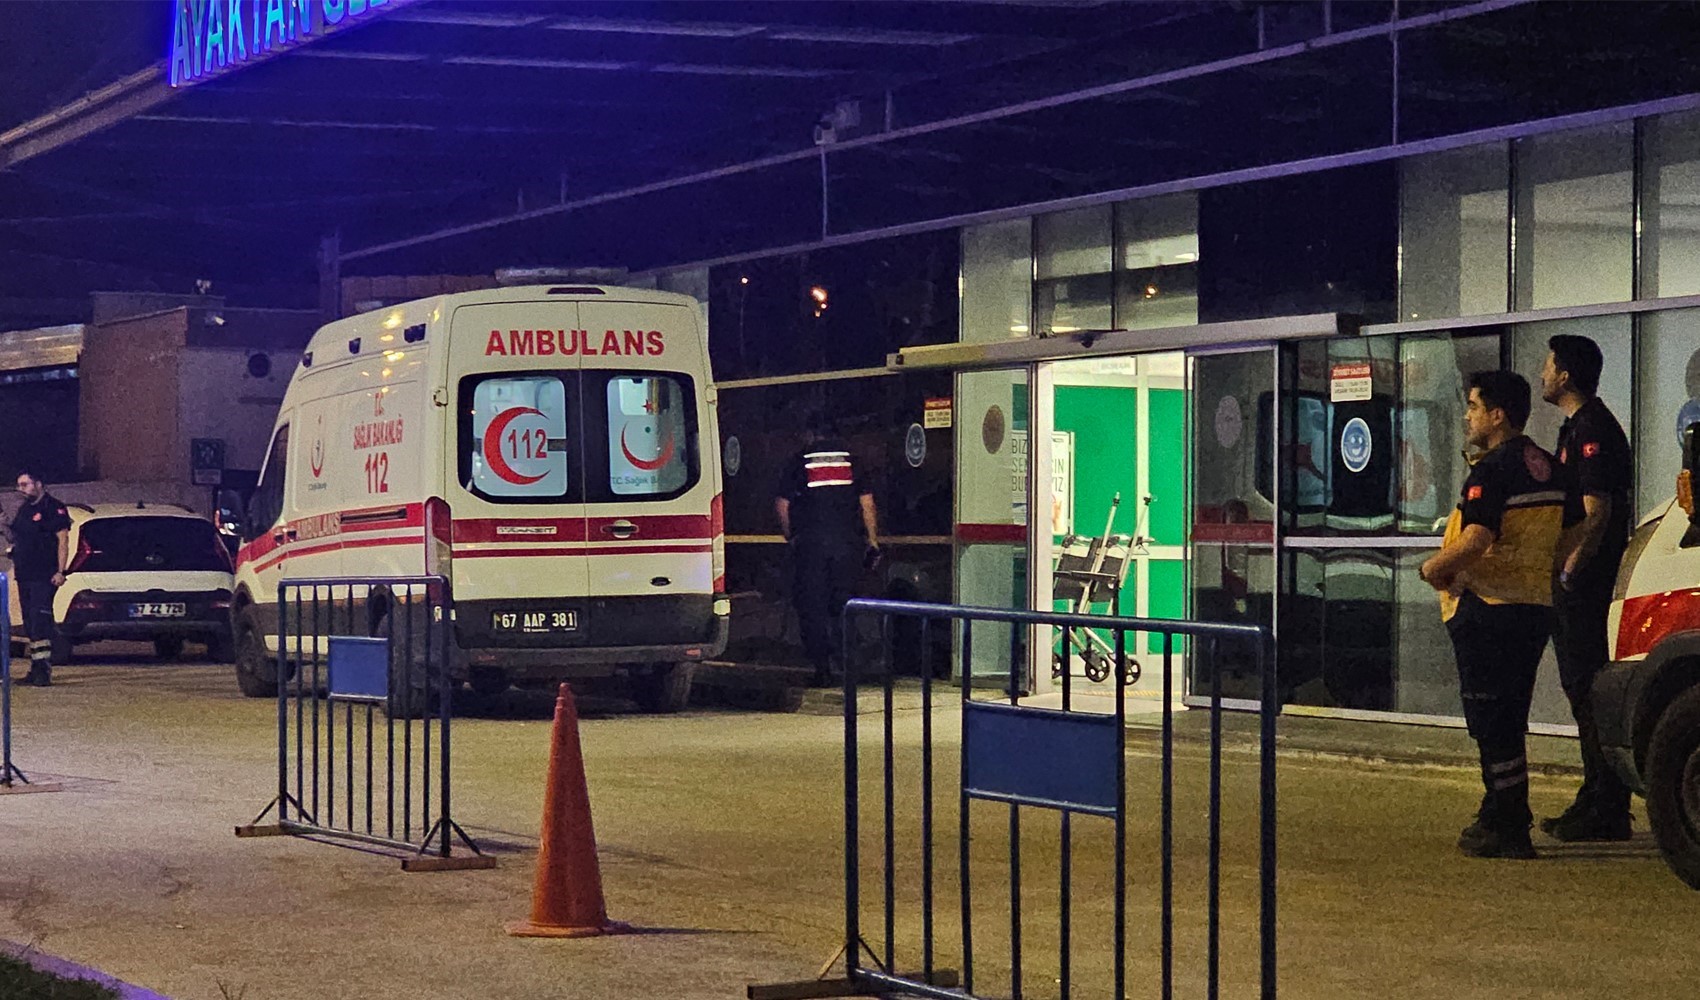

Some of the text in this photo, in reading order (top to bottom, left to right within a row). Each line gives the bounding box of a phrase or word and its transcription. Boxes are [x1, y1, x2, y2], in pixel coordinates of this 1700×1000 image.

[485, 329, 664, 356] AMBULANS
[507, 429, 547, 459] 112
[365, 452, 388, 494] 112
[502, 612, 573, 628] 67 AAP 381
